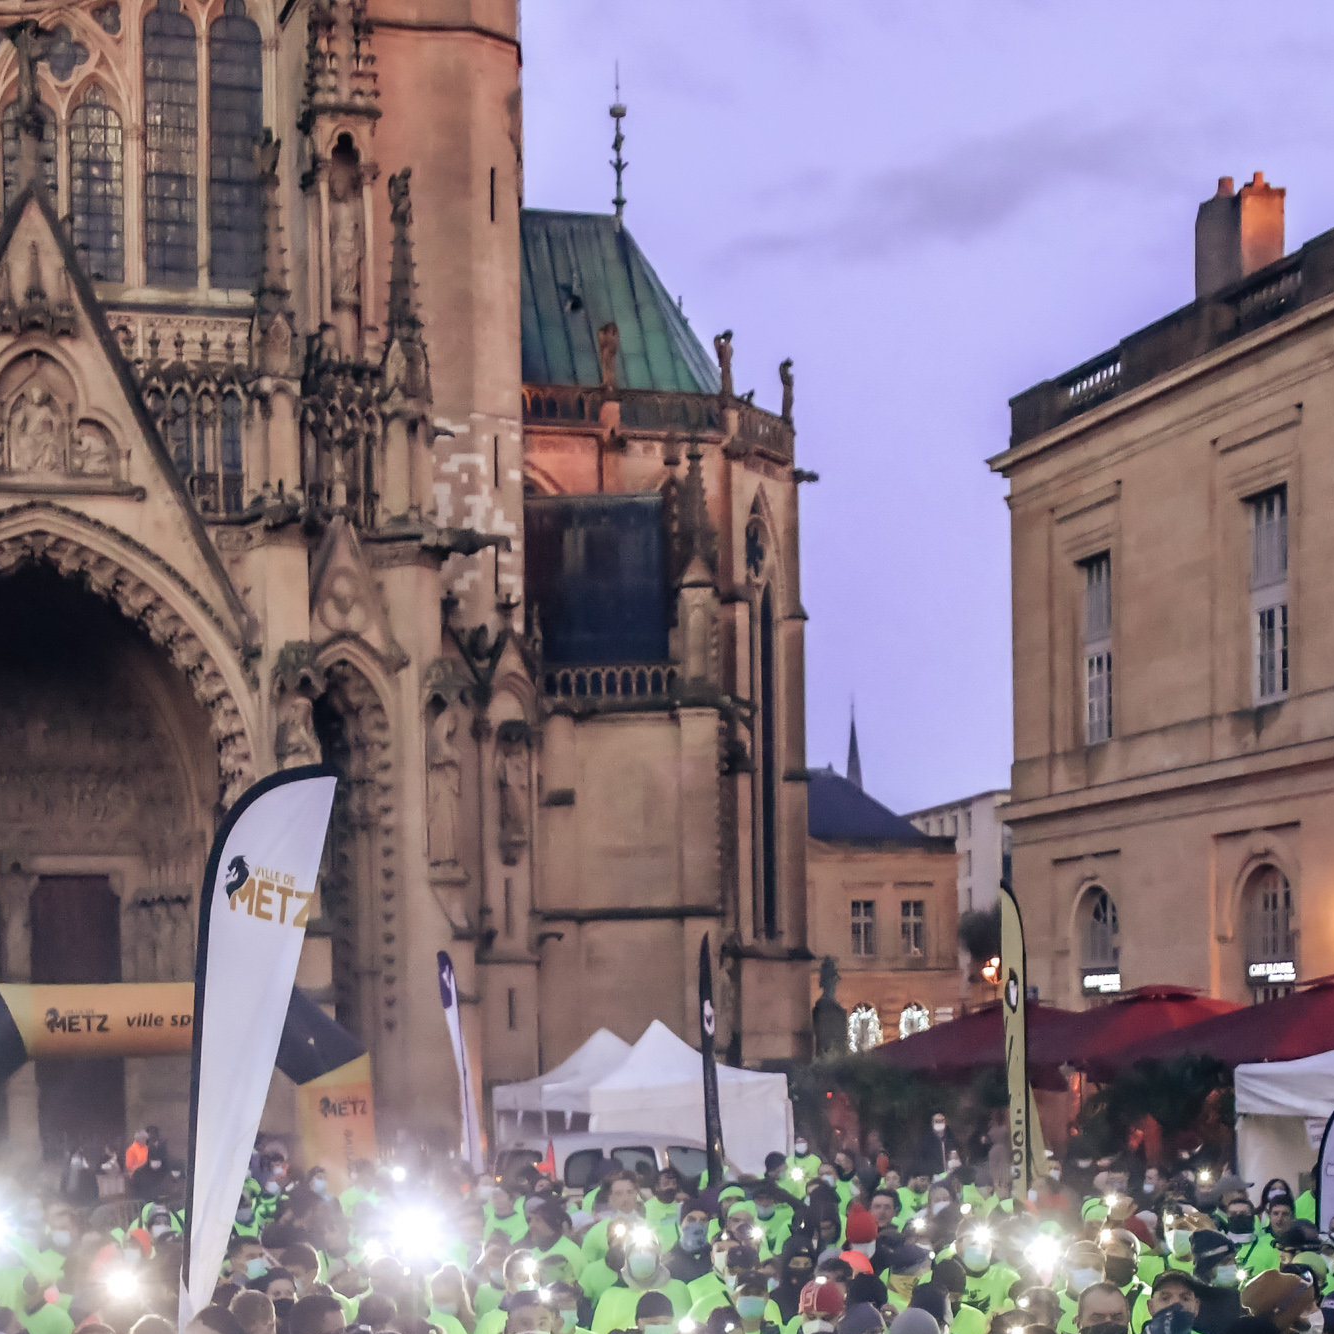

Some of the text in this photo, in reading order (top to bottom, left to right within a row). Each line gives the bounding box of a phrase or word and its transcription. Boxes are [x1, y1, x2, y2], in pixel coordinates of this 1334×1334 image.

[255, 866, 296, 887] VILLE DE
[230, 877, 314, 928] METZ
[47, 1012, 193, 1034] METZ ville sp
[327, 1100, 367, 1117] METZ
